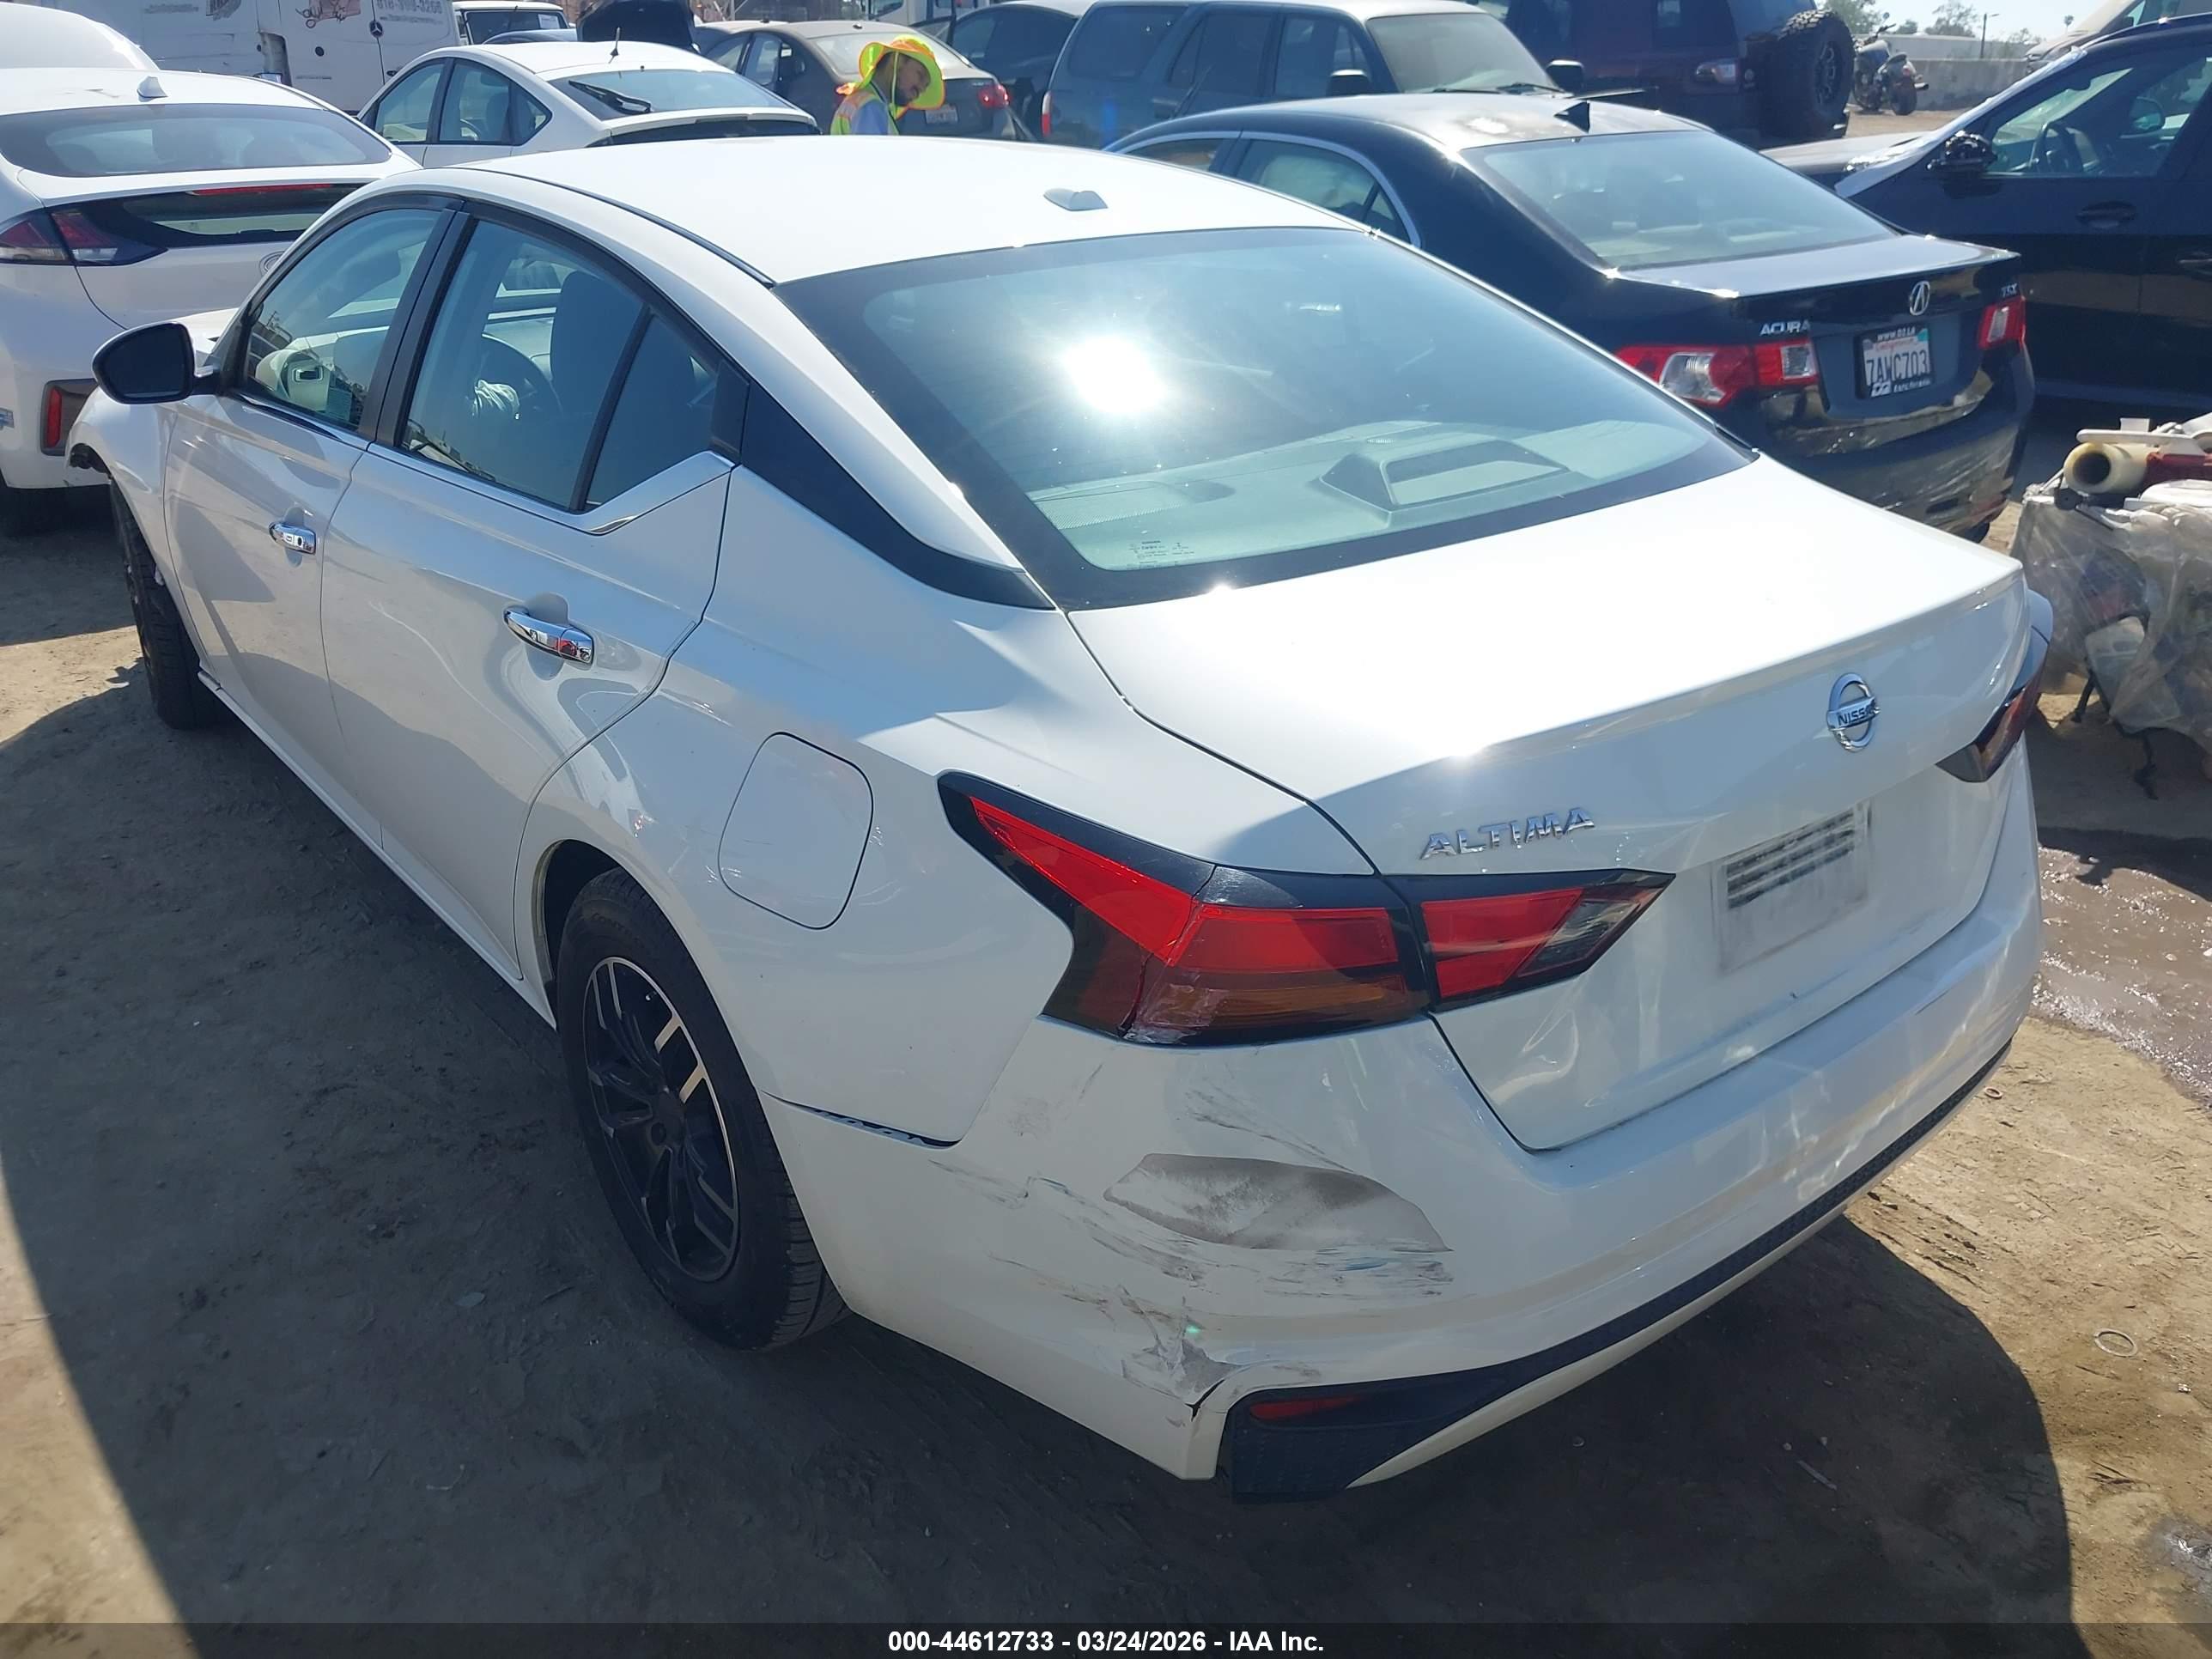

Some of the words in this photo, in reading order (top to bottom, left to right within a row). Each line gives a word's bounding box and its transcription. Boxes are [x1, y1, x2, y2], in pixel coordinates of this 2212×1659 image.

[1759, 319, 1810, 337] ACURA
[1837, 702, 1875, 726] NISS
[1419, 807, 1595, 860] ALTIMA
